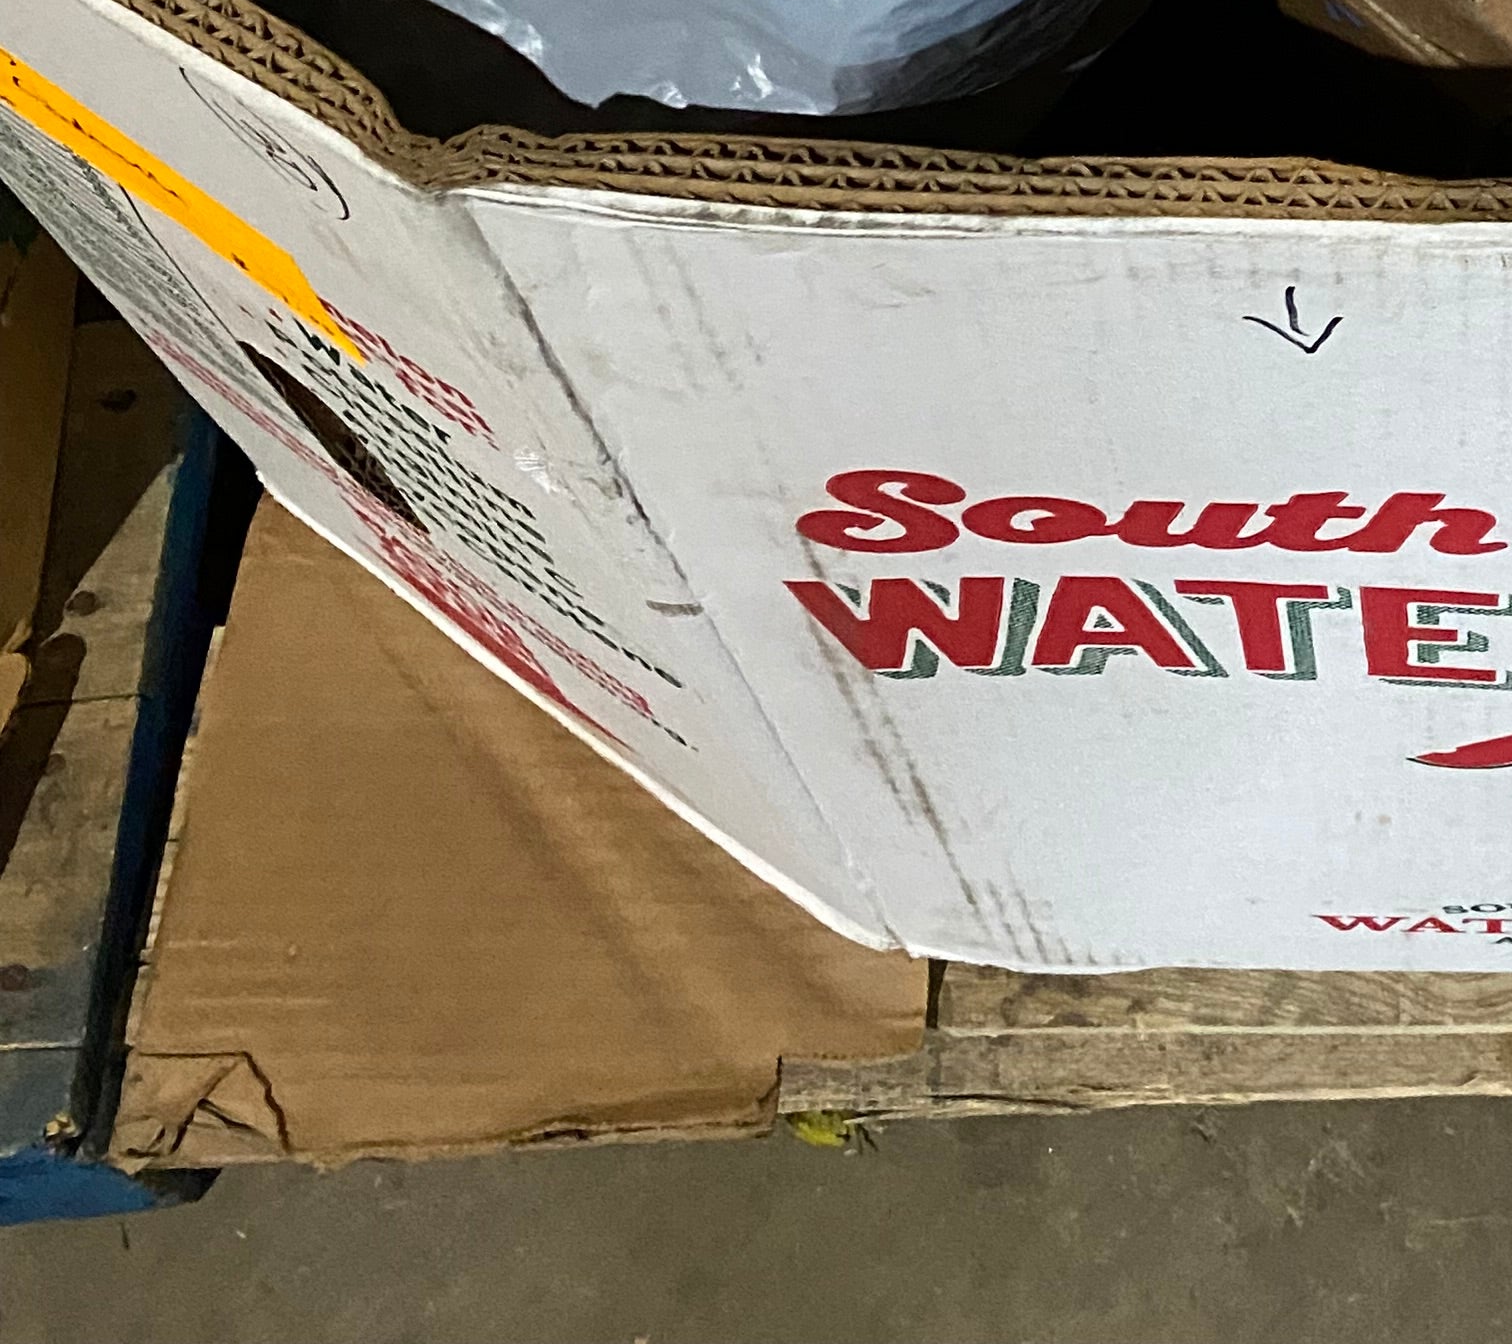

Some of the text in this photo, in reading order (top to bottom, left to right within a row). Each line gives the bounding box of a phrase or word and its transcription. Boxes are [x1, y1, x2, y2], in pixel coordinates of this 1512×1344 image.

[265, 320, 537, 520] Potassium
[293, 317, 452, 445] Water
[301, 363, 547, 543] Citrulline
[341, 408, 555, 566] Arginine
[795, 468, 1509, 556] South
[456, 533, 684, 689] Carotene
[543, 566, 585, 600] C
